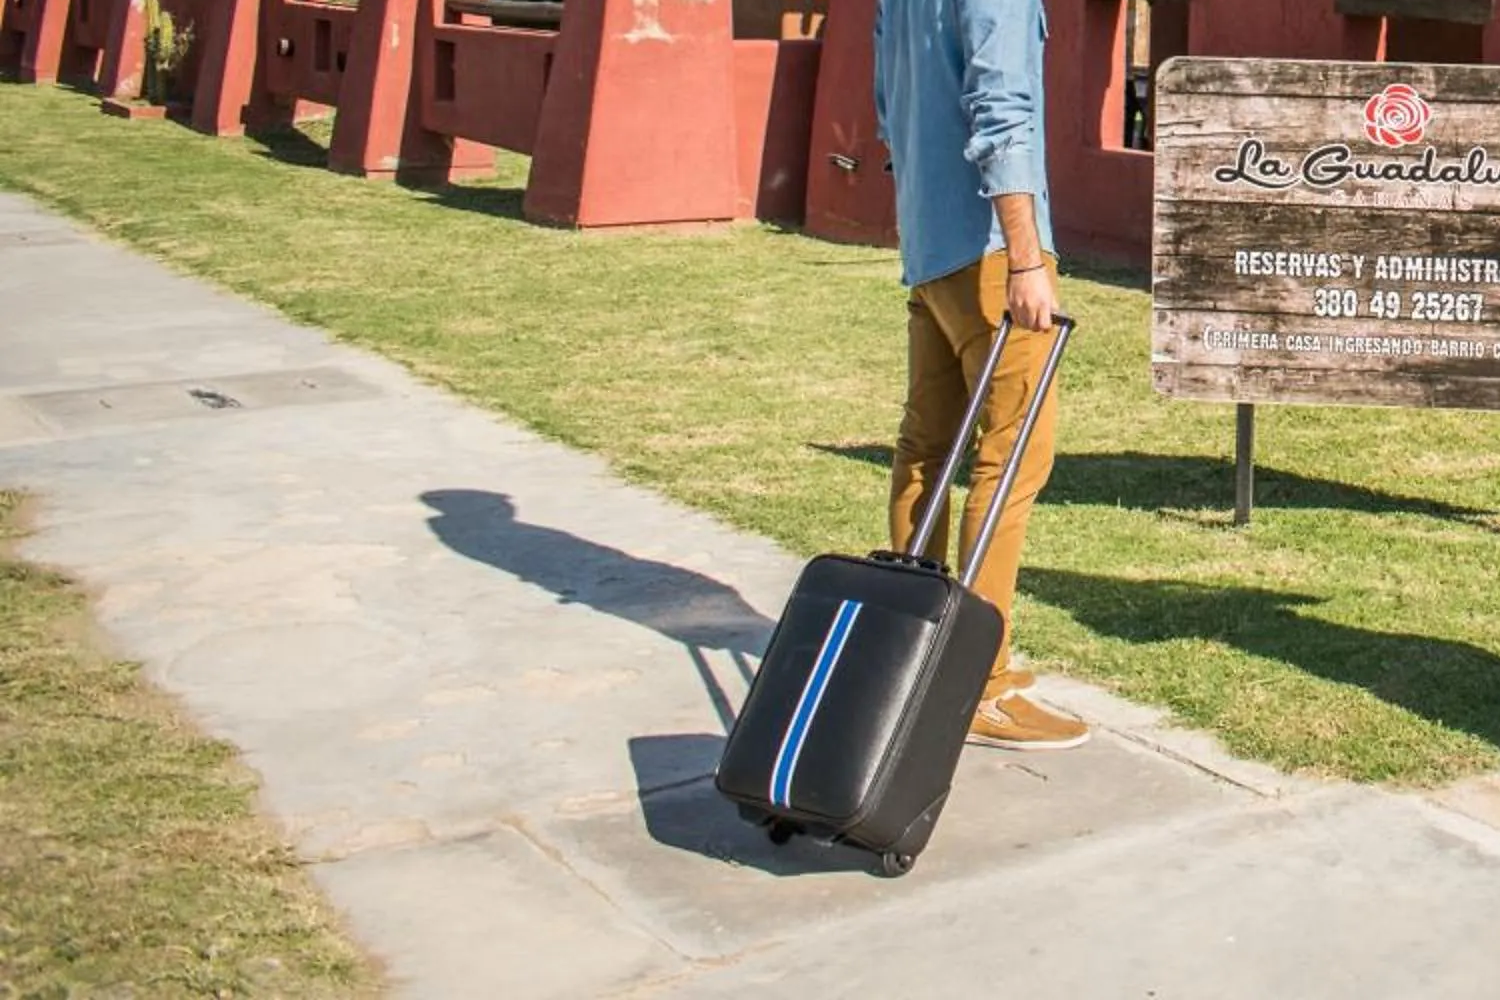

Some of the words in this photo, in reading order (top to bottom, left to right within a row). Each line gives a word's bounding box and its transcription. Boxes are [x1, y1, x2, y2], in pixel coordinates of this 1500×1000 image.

[1213, 138, 1301, 189] La
[1234, 250, 1342, 278] RESERVAS
[1352, 254, 1365, 279] Y
[1313, 288, 1358, 317] 380
[1369, 290, 1401, 319] 49
[1410, 291, 1484, 321] 25267
[1203, 325, 1279, 351] (PRIMERA
[1285, 334, 1321, 351] CASA
[1328, 335, 1423, 355] INGRESANDO
[1431, 339, 1485, 359] BARRIO
